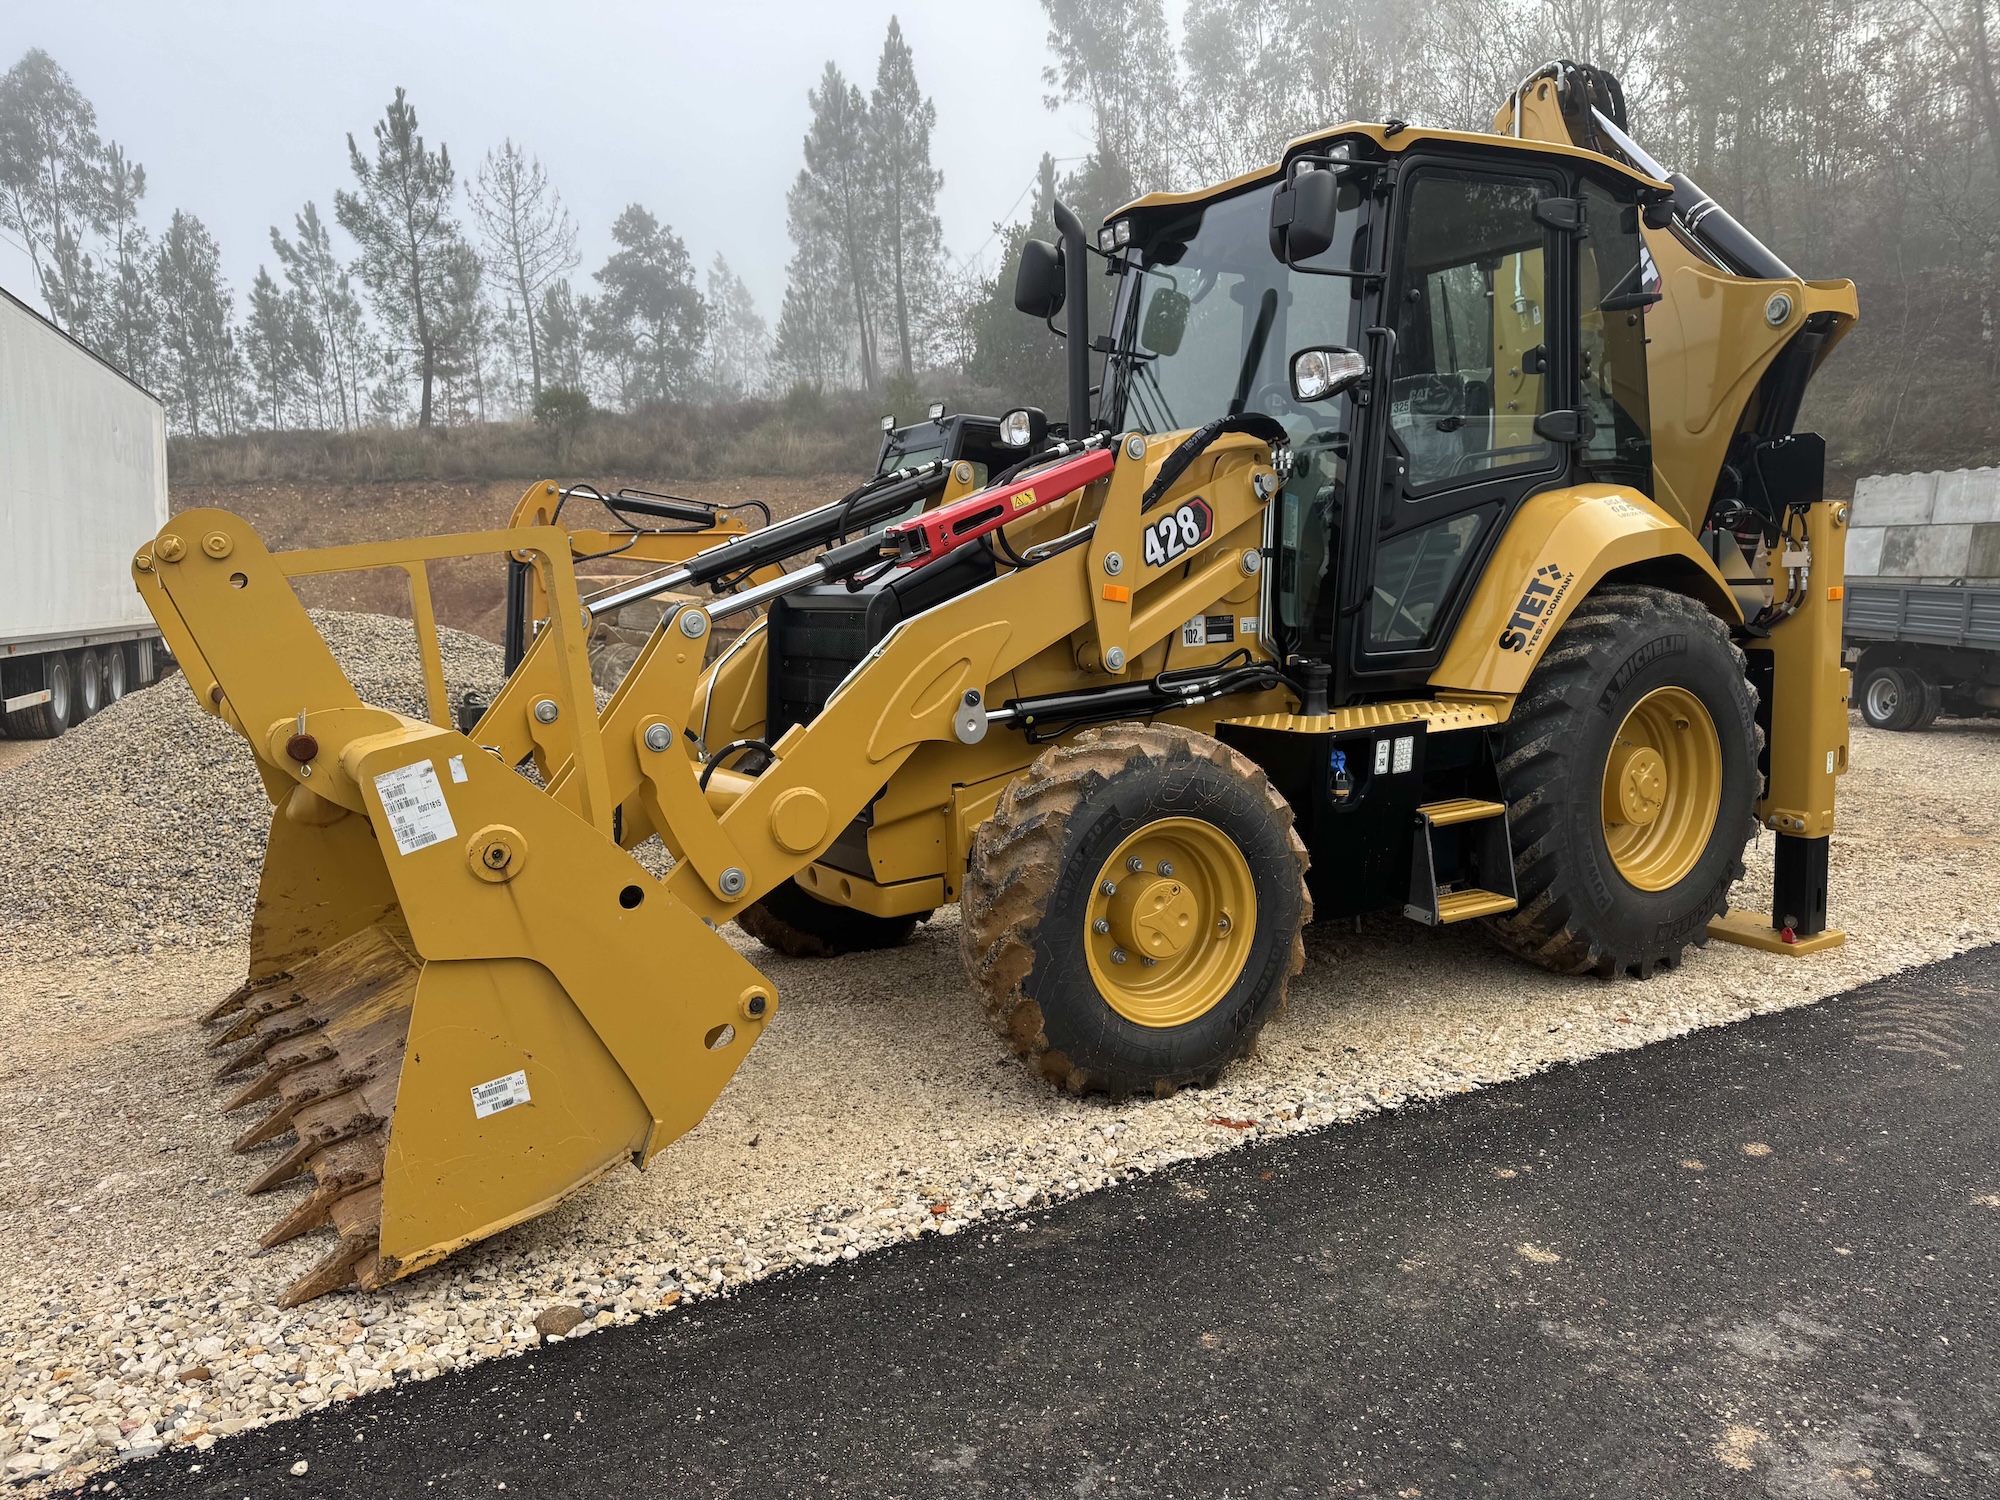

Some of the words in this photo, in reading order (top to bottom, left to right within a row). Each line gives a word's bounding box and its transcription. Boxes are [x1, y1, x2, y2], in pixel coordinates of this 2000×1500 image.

[1393, 401, 1409, 413] 325
[1409, 387, 1430, 402] CAT
[1145, 505, 1200, 565] 428
[1499, 577, 1555, 652] STET
[1546, 572, 1574, 616] COMPANY
[1184, 629, 1198, 644] 102
[1616, 635, 1687, 690] MICHELIN
